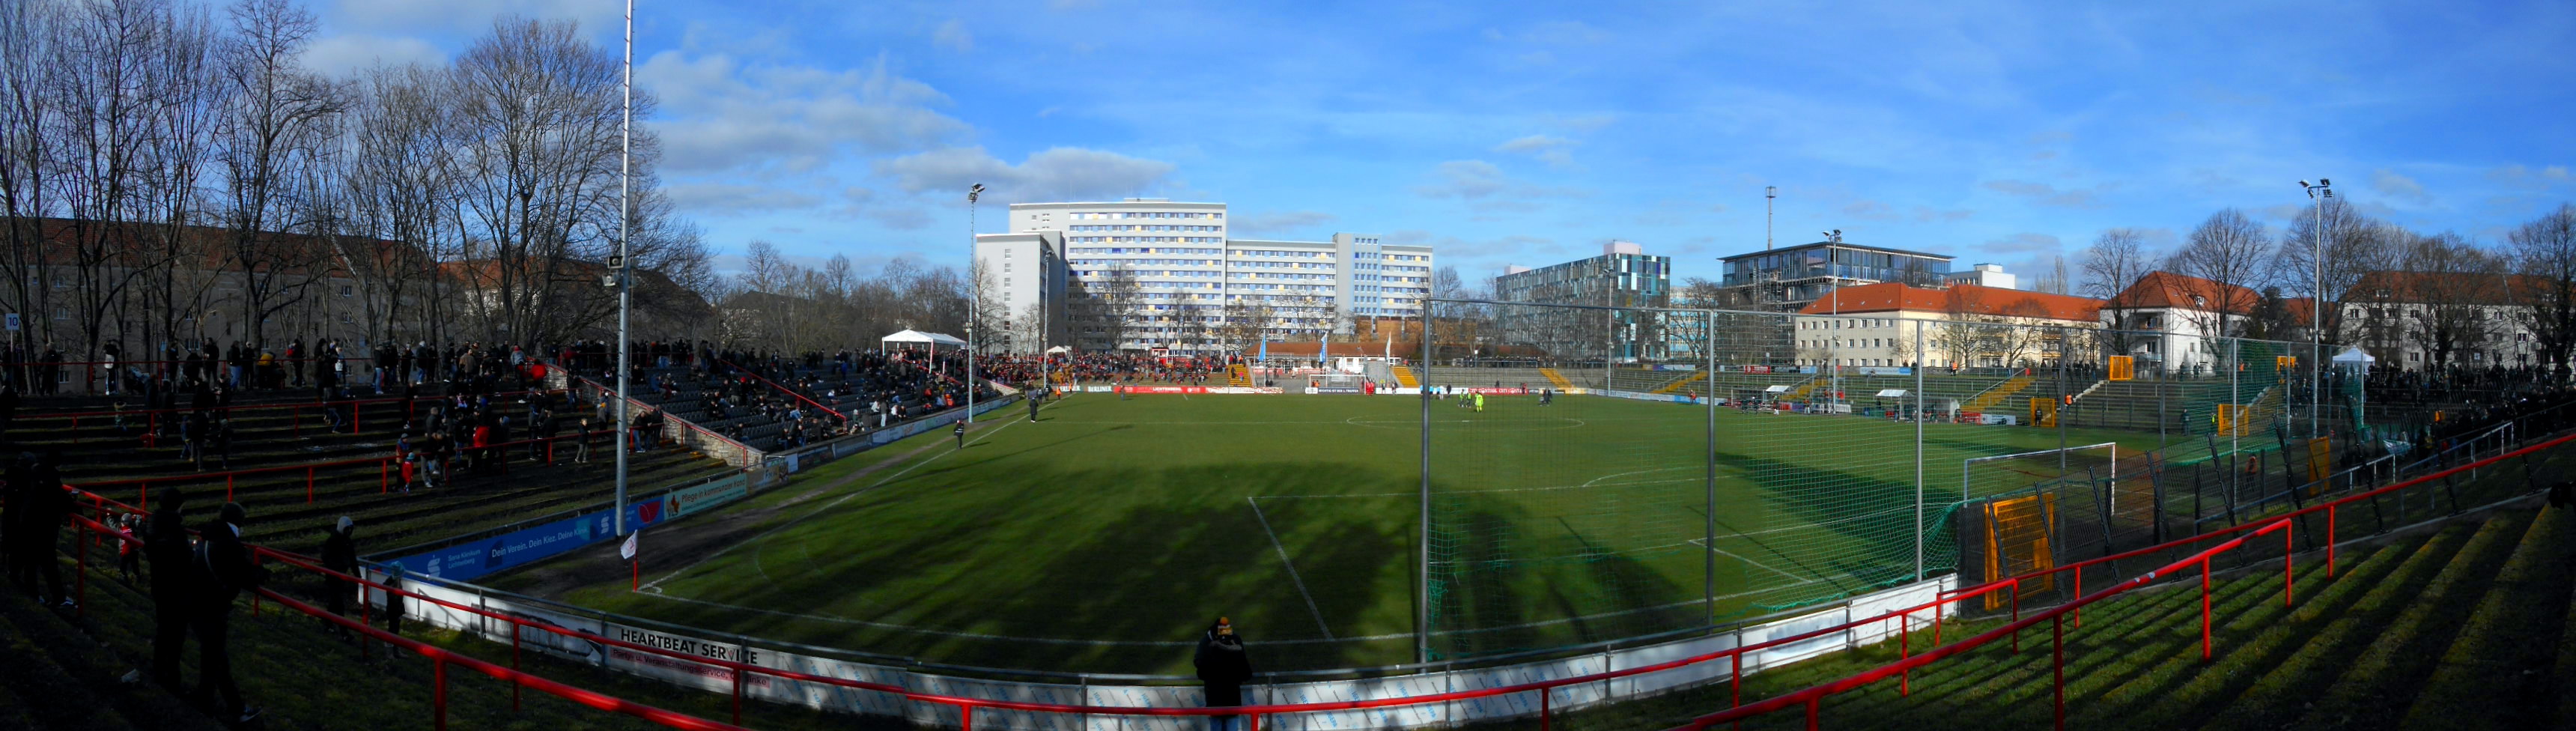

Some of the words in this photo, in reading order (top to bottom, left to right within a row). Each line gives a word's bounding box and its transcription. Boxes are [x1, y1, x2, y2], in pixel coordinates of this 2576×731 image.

[8, 317, 18, 326] 10
[681, 494, 698, 503] Pflege
[492, 548, 506, 558] Dein
[508, 543, 528, 553] Verein.
[529, 539, 542, 548] Dein
[543, 534, 556, 544] Kiez.
[558, 531, 573, 540] Deine
[461, 549, 481, 559] Klinikum
[448, 558, 476, 569] Lichtenberg
[621, 628, 696, 654] HEARTBEAT
[613, 649, 634, 661] Party-
